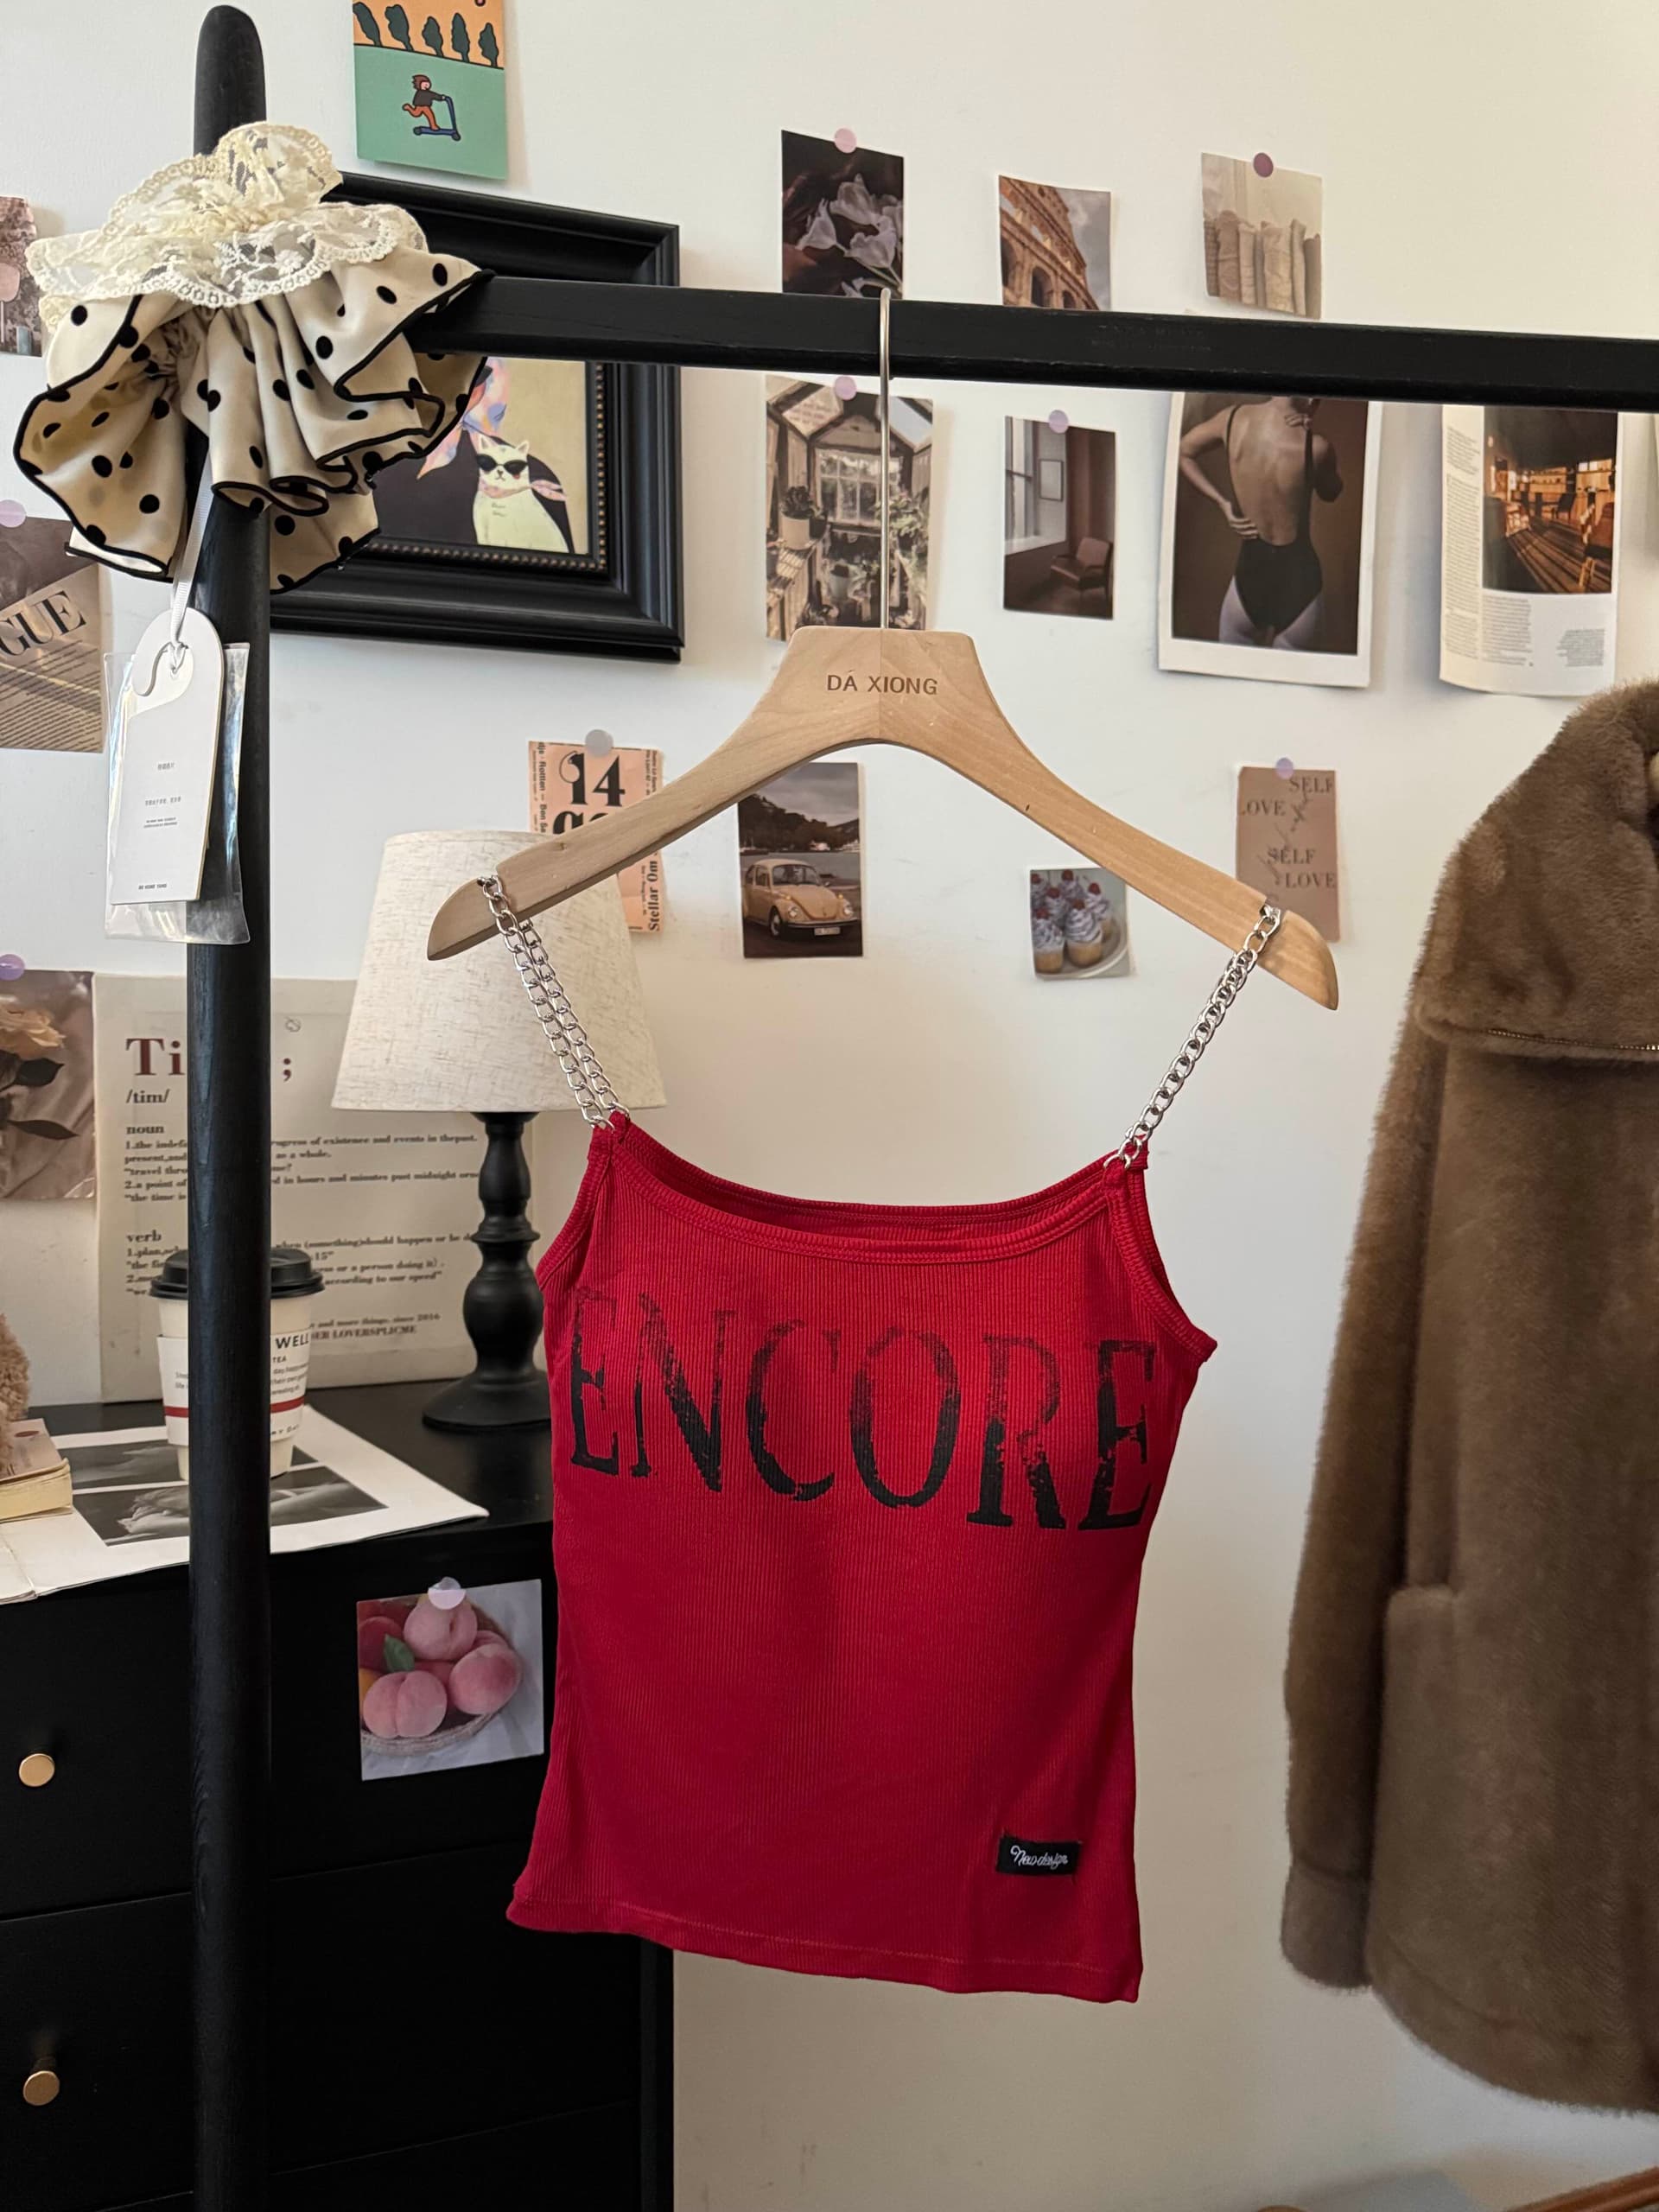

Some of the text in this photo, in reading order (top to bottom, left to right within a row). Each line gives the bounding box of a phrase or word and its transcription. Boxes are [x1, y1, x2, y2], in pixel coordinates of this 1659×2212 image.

[827, 675, 938, 695] DA XIONG
[559, 750, 626, 807] 14
[1289, 777, 1332, 792] SELF
[1238, 799, 1286, 816] OVE
[1268, 849, 1316, 864] SELF
[1285, 873, 1335, 888] LOVE
[648, 887, 659, 931] Stellar
[126, 1229, 162, 1243] verb
[569, 1284, 1156, 1532] ENCORE
